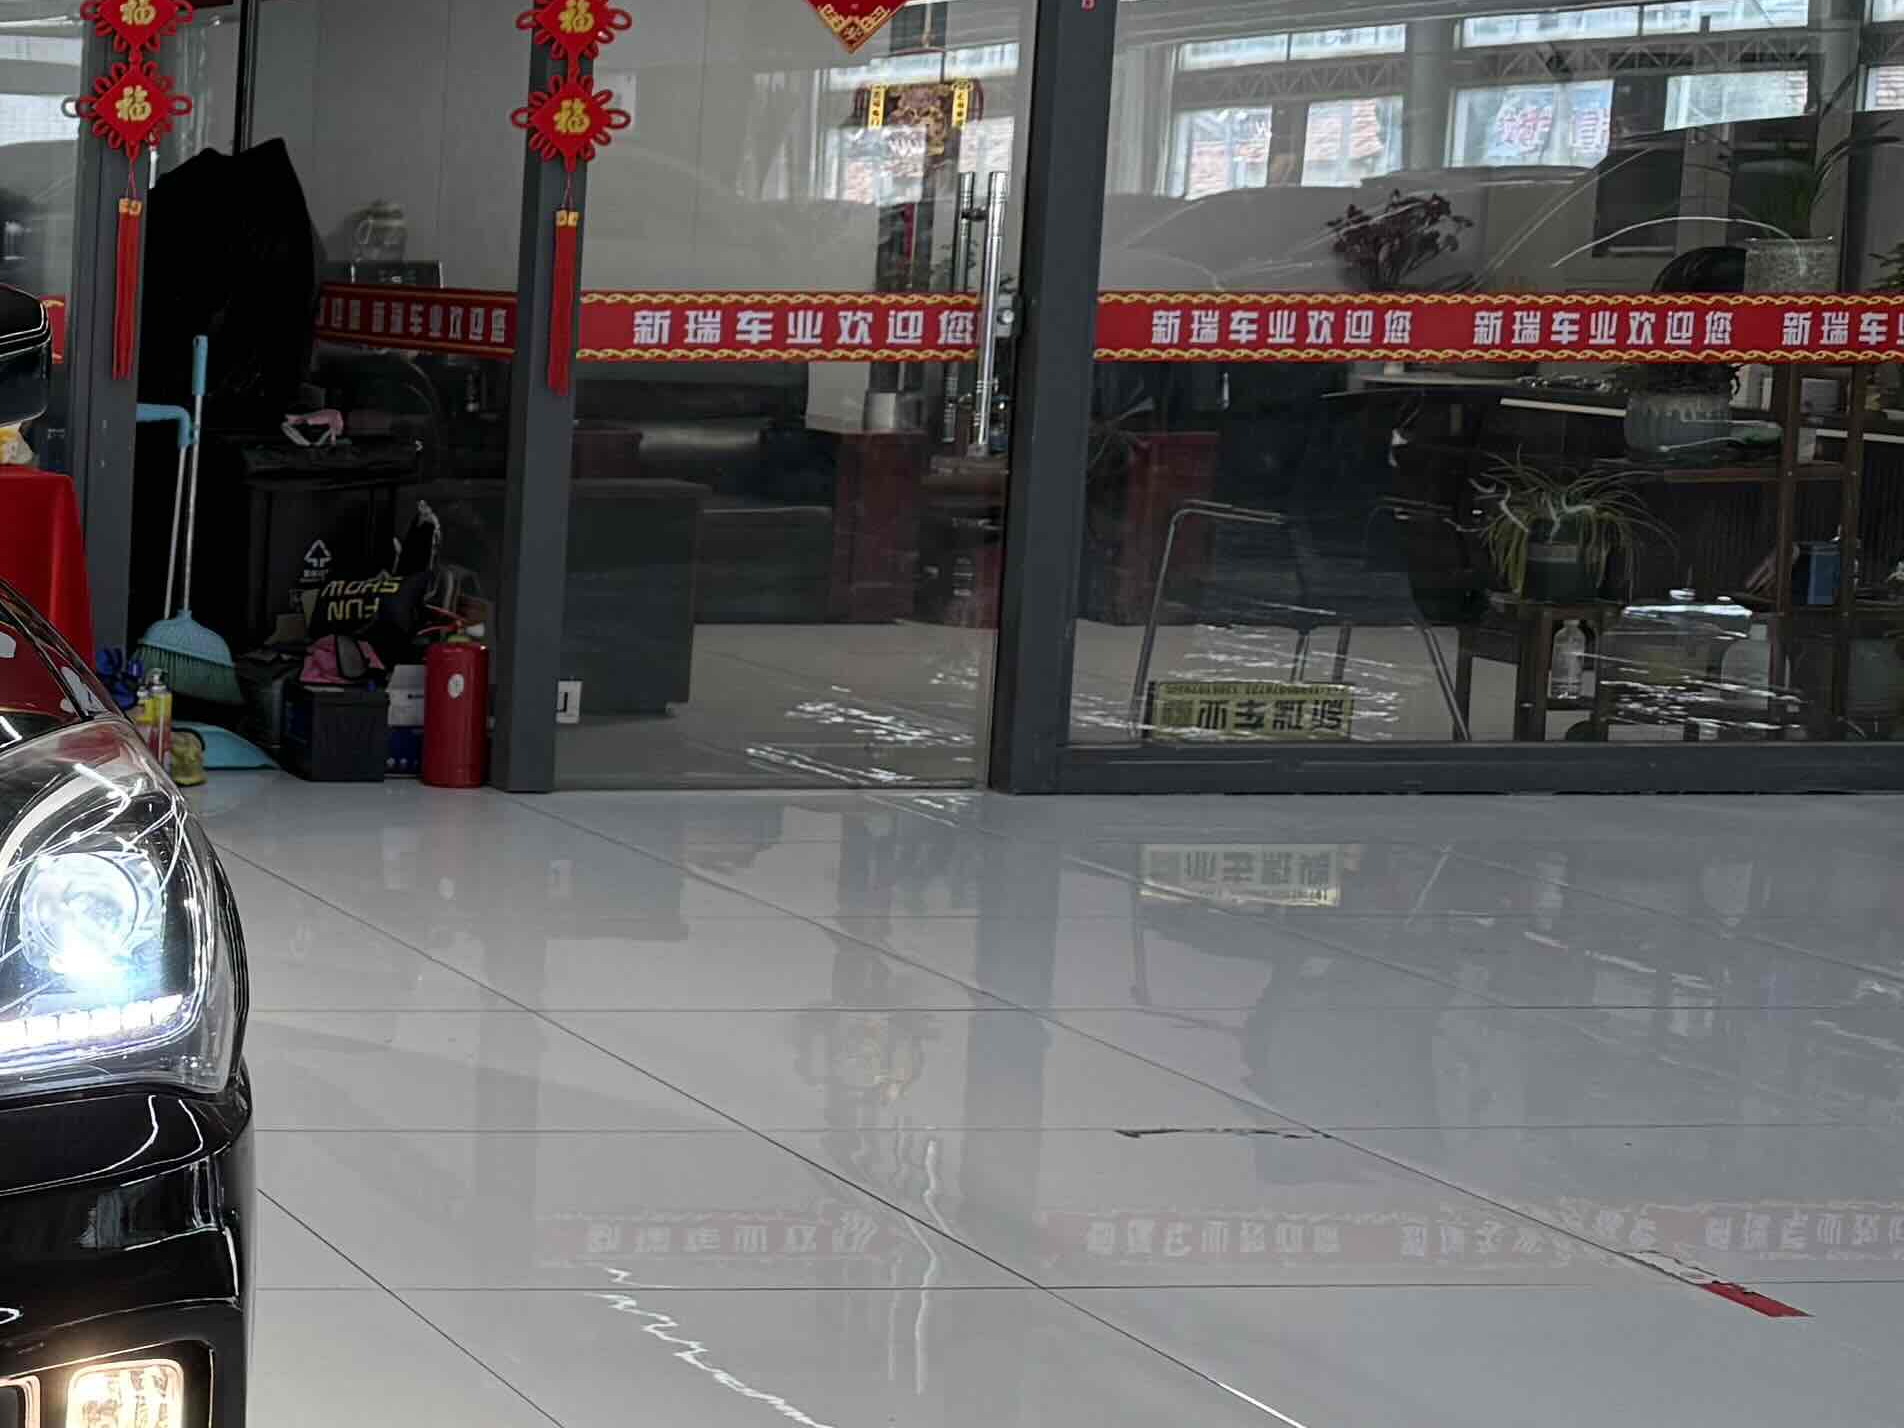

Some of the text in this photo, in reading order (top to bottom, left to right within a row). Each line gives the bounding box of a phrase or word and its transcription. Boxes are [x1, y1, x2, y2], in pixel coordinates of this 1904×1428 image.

[116, 85, 151, 121] 福
[554, 99, 590, 134] 福
[633, 310, 975, 345] 新瑞车业欢迎您
[1151, 309, 1413, 345] 新瑞车业欢迎您
[1473, 309, 1734, 345] 新瑞车业欢迎您
